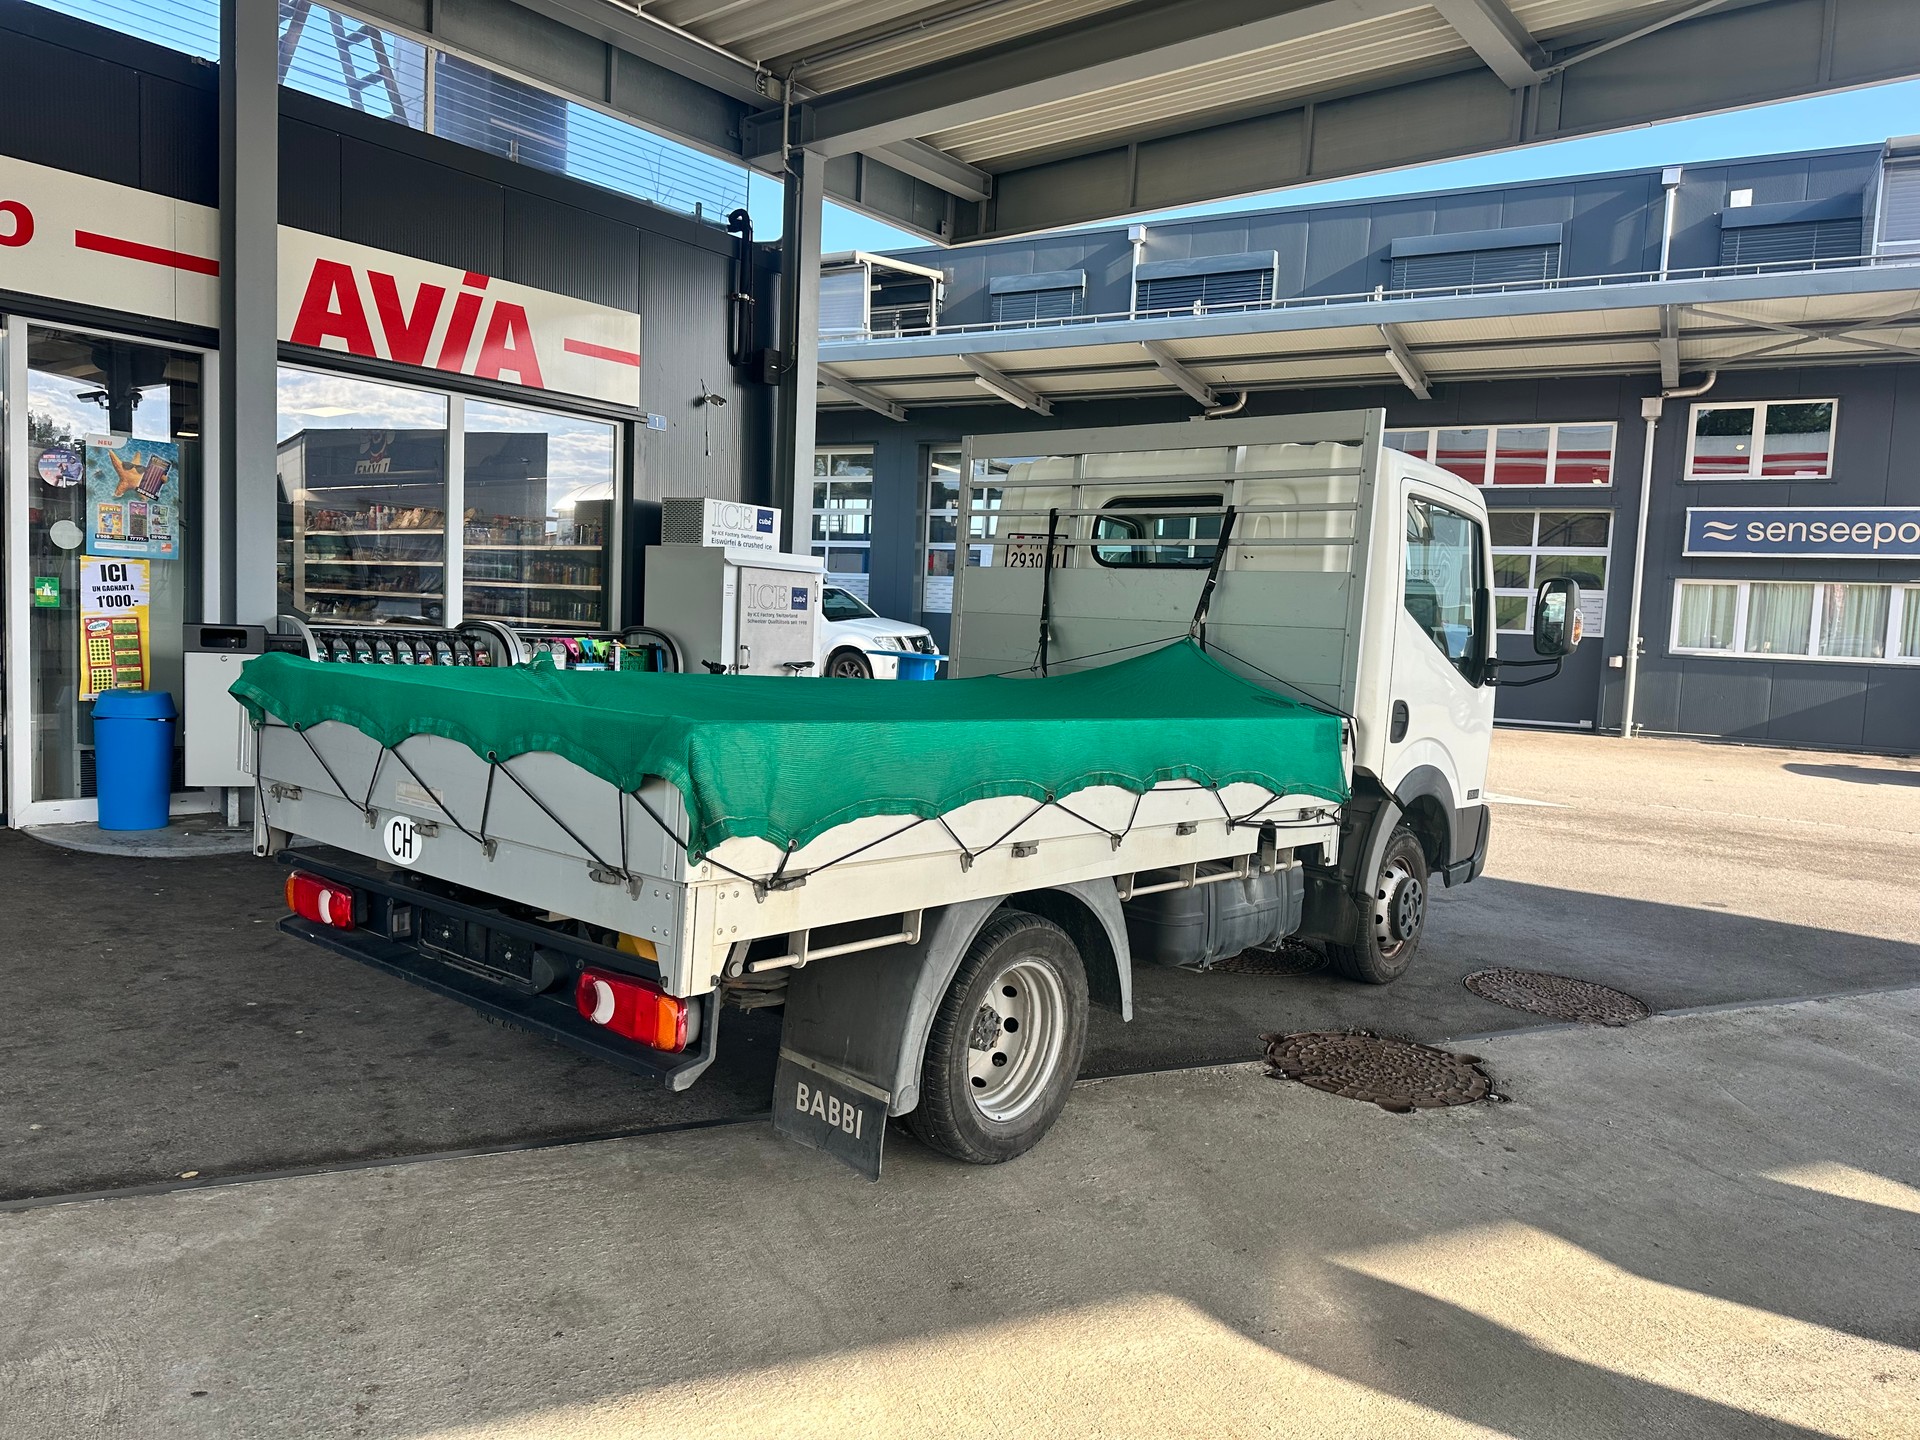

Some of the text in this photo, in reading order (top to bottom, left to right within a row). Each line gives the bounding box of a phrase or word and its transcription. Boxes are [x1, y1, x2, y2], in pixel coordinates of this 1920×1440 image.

[712, 502, 772, 531] ICE cube
[711, 538, 737, 546] Eiswürfel
[743, 541, 763, 550] crushed
[741, 533, 763, 541] Switzerland
[100, 564, 127, 582] ICI
[96, 594, 139, 607] 1'000.-
[748, 584, 788, 610] ICE
[793, 595, 806, 603] cube
[392, 821, 413, 858] CH
[796, 1081, 863, 1140] BABBI
